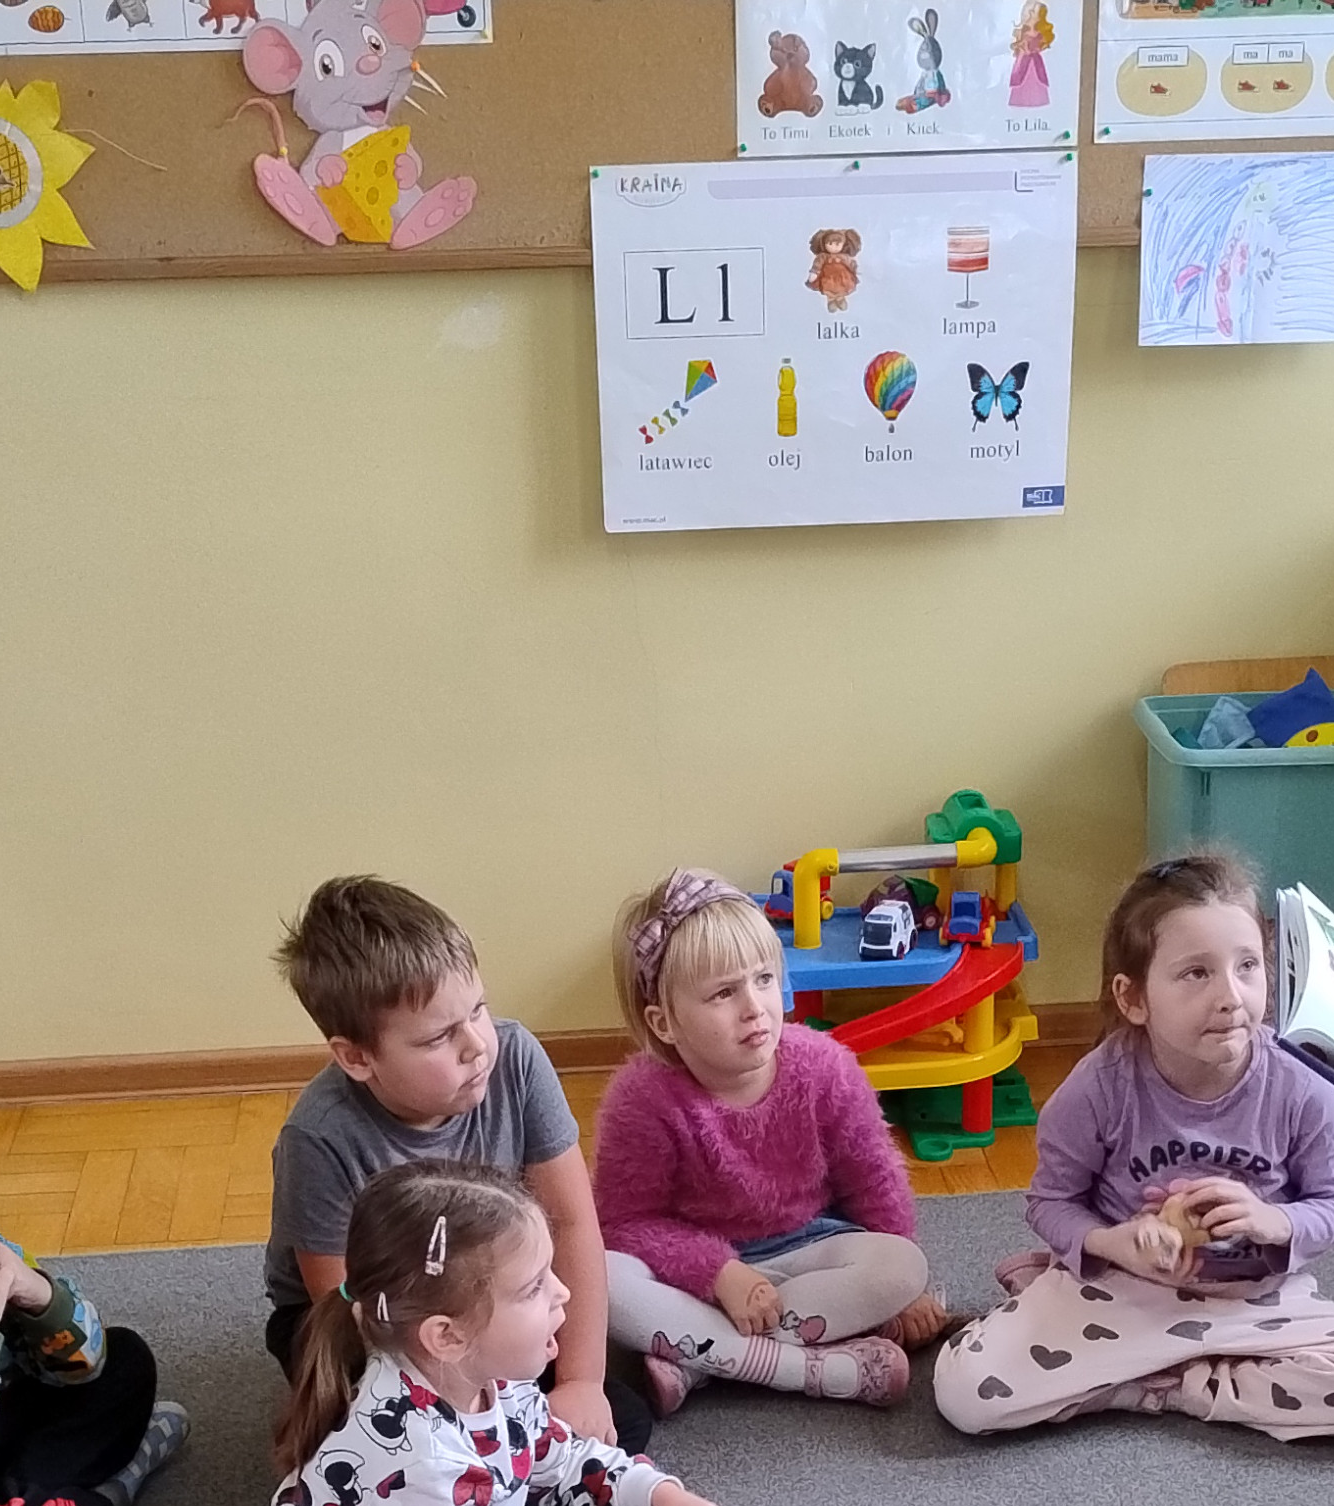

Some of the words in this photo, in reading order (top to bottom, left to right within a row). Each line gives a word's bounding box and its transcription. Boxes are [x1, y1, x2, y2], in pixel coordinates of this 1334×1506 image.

[1147, 52, 1179, 63] mama
[1243, 49, 1259, 60] ma
[1278, 48, 1294, 59] ma
[761, 126, 777, 140] To
[1005, 119, 1021, 132] To
[652, 266, 697, 325] L
[717, 263, 735, 322] l
[817, 321, 861, 340] lalka
[943, 317, 997, 338] lampa
[768, 448, 801, 470] olej
[865, 444, 913, 462] balon
[970, 439, 1020, 462] motyl
[639, 453, 713, 471] latawiec
[1128, 1140, 1272, 1183] HAPPIER
